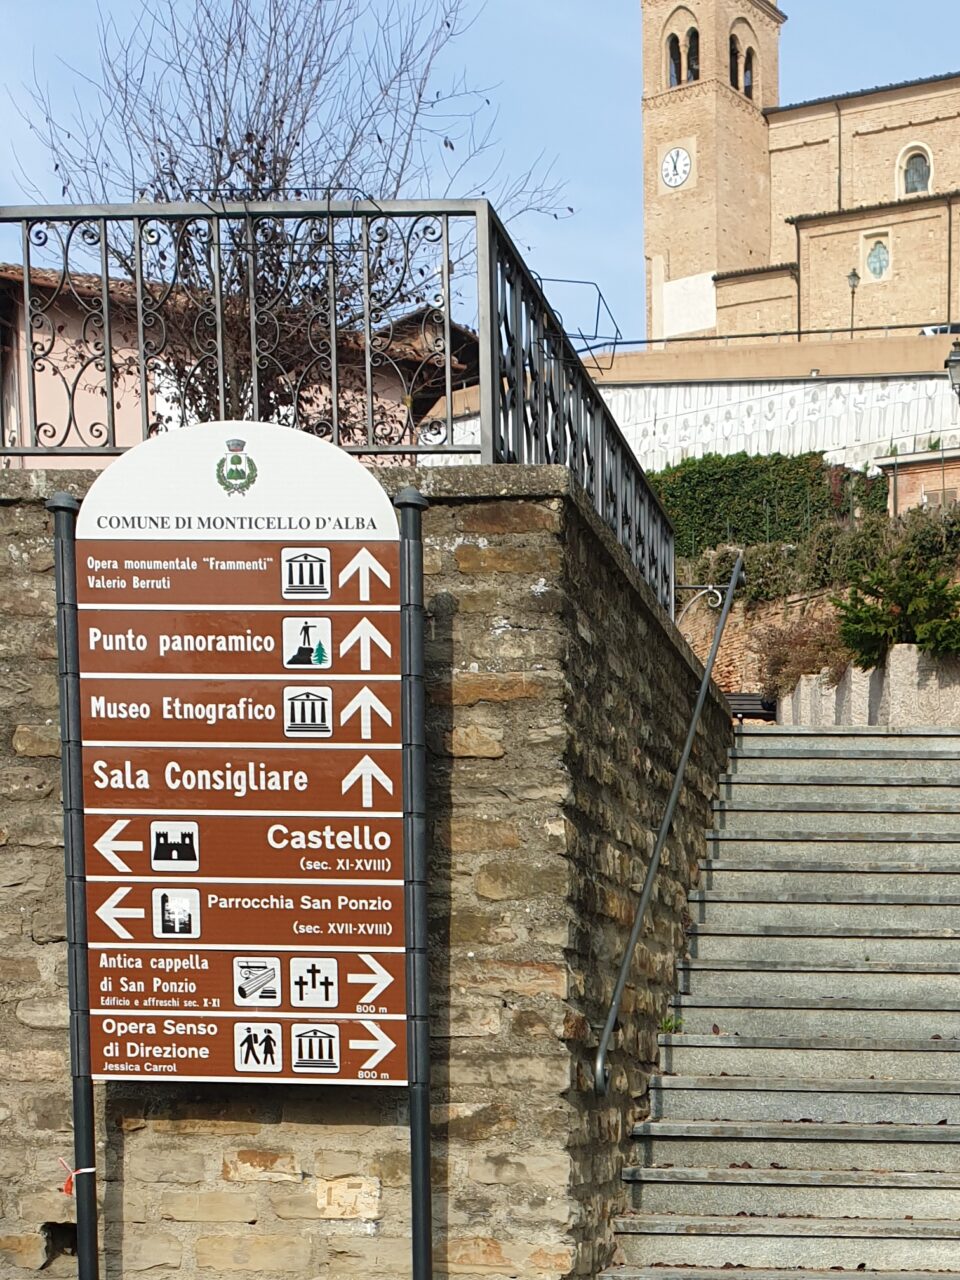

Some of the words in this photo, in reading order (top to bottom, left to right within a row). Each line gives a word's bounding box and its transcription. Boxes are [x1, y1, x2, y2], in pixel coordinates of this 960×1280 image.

[97, 516, 170, 529] COMUNE
[175, 516, 192, 529] DI
[197, 516, 310, 530] MONTICELLO
[87, 557, 118, 572] Opera
[124, 558, 197, 570] monumentale
[87, 576, 127, 588] Valerio
[133, 577, 170, 589] Berruti
[89, 628, 147, 651] Punto
[160, 629, 275, 656] panoramico
[90, 696, 150, 719] Museo
[163, 697, 276, 724] Etnografico
[93, 761, 149, 790] Sala
[165, 762, 308, 796] Consigliare
[267, 824, 391, 850] Castello
[300, 858, 332, 871] (sec.
[336, 859, 391, 872] XI-XVIII)
[208, 895, 294, 909] Parrocchia
[300, 896, 331, 910] San
[338, 896, 392, 910] Ponzio
[293, 922, 323, 934] (sec.
[327, 922, 393, 935] XVII-XVIII)
[99, 954, 142, 969] Antica
[150, 955, 208, 972] cappella
[100, 978, 112, 991] di
[120, 978, 145, 991] San
[152, 979, 197, 993] Ponzio
[100, 997, 130, 1006] Edificio
[143, 998, 180, 1007] affreschi
[183, 999, 199, 1007] sec.
[356, 1004, 376, 1013] 800
[102, 1019, 156, 1038] Opera
[163, 1021, 217, 1035] Senso
[103, 1043, 119, 1057] di
[126, 1043, 209, 1058] Direzione
[103, 1062, 140, 1072] Jessica
[144, 1062, 177, 1072] Carrol
[358, 1071, 377, 1079] 800
